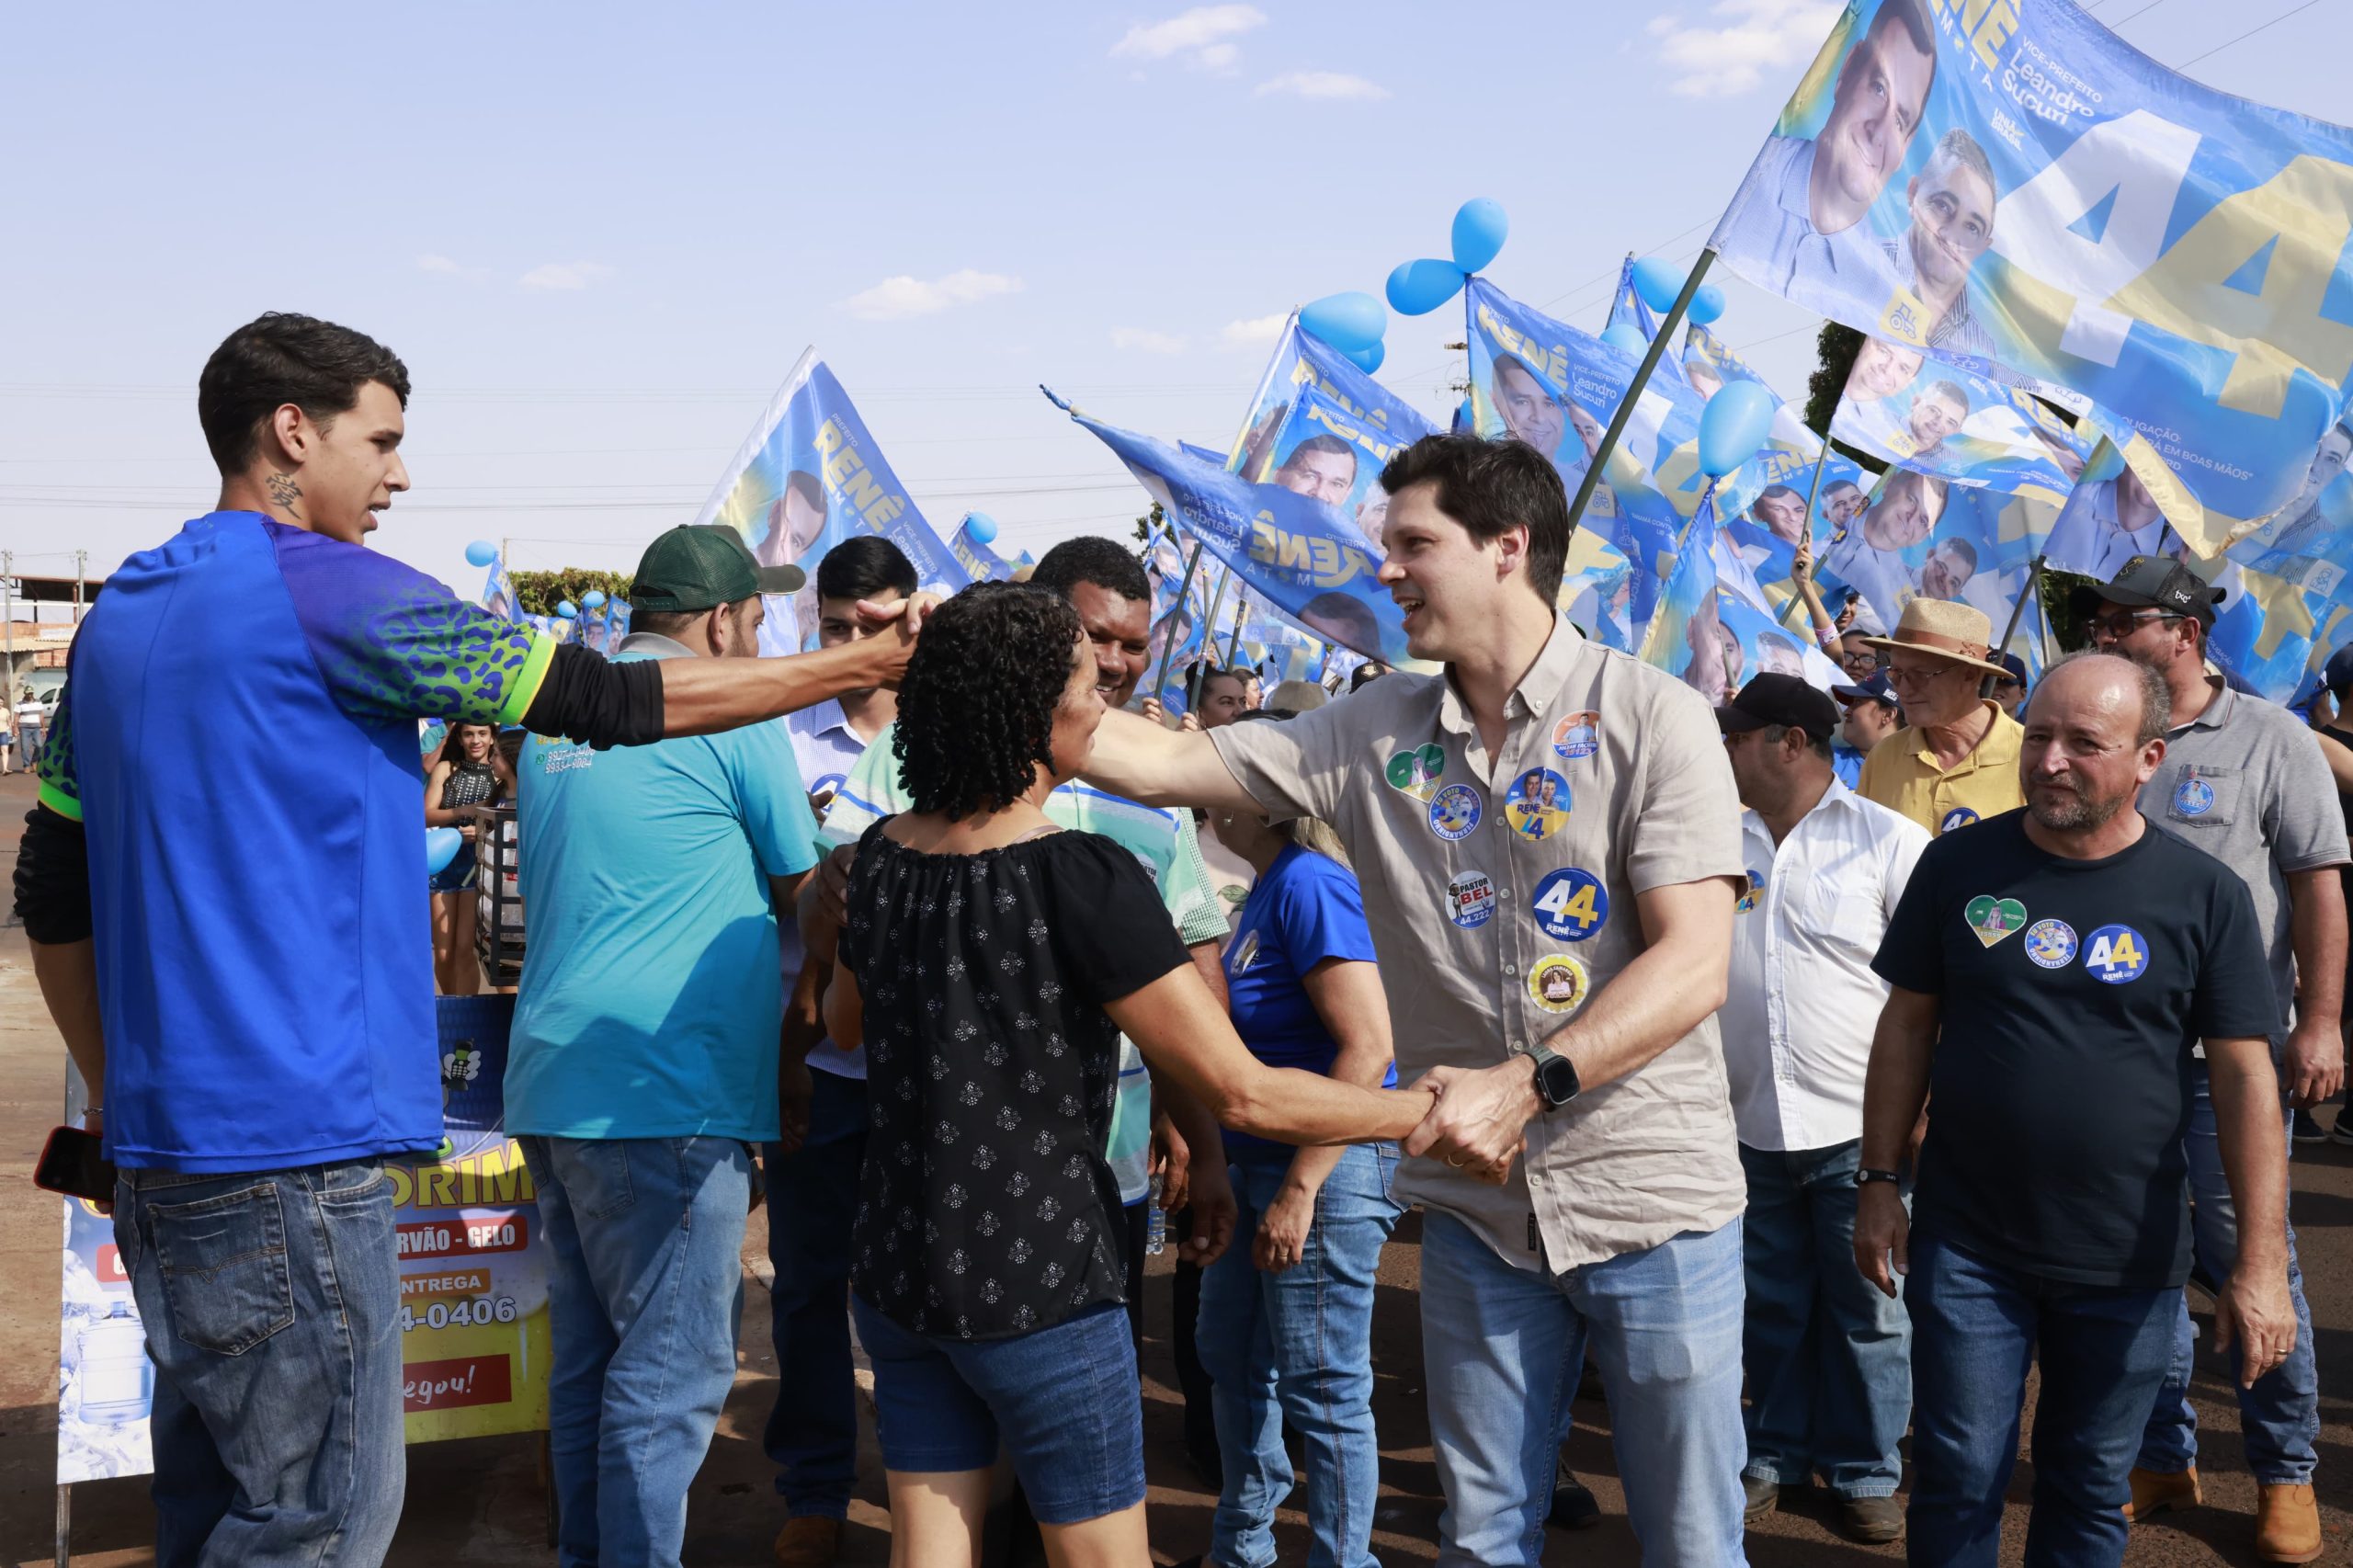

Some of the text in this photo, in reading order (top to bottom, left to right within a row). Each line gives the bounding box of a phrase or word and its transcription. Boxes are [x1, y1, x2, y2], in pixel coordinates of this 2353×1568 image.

[2022, 36, 2103, 103] VICE-PREFEITO
[2009, 47, 2095, 117] Leandro
[2002, 68, 2070, 125] Sucuri
[1991, 108, 2353, 419] 44
[1573, 372, 1618, 399] Leandro
[1574, 363, 1621, 386] VICE-PREFEITO
[1573, 385, 1607, 408] Sucuri
[830, 413, 858, 448] PREFEITO
[2163, 444, 2181, 457] EM
[2182, 450, 2213, 469] BOAS
[813, 418, 905, 534] RENÊ
[903, 520, 938, 573] VICE-PREFEITO
[1443, 788, 1460, 798] VOTO
[1434, 819, 1474, 838] FERNANDINHO
[1460, 878, 1489, 892] PASTOR
[1460, 886, 1494, 905] BEL
[1533, 879, 1598, 929] 44
[1460, 910, 1490, 926] 44.222
[1546, 923, 1570, 936] RENÊ
[2038, 921, 2054, 931] VOTO
[2029, 948, 2071, 967] FERNANDINHO
[2085, 932, 2143, 971] 44
[467, 1224, 516, 1248] GELO
